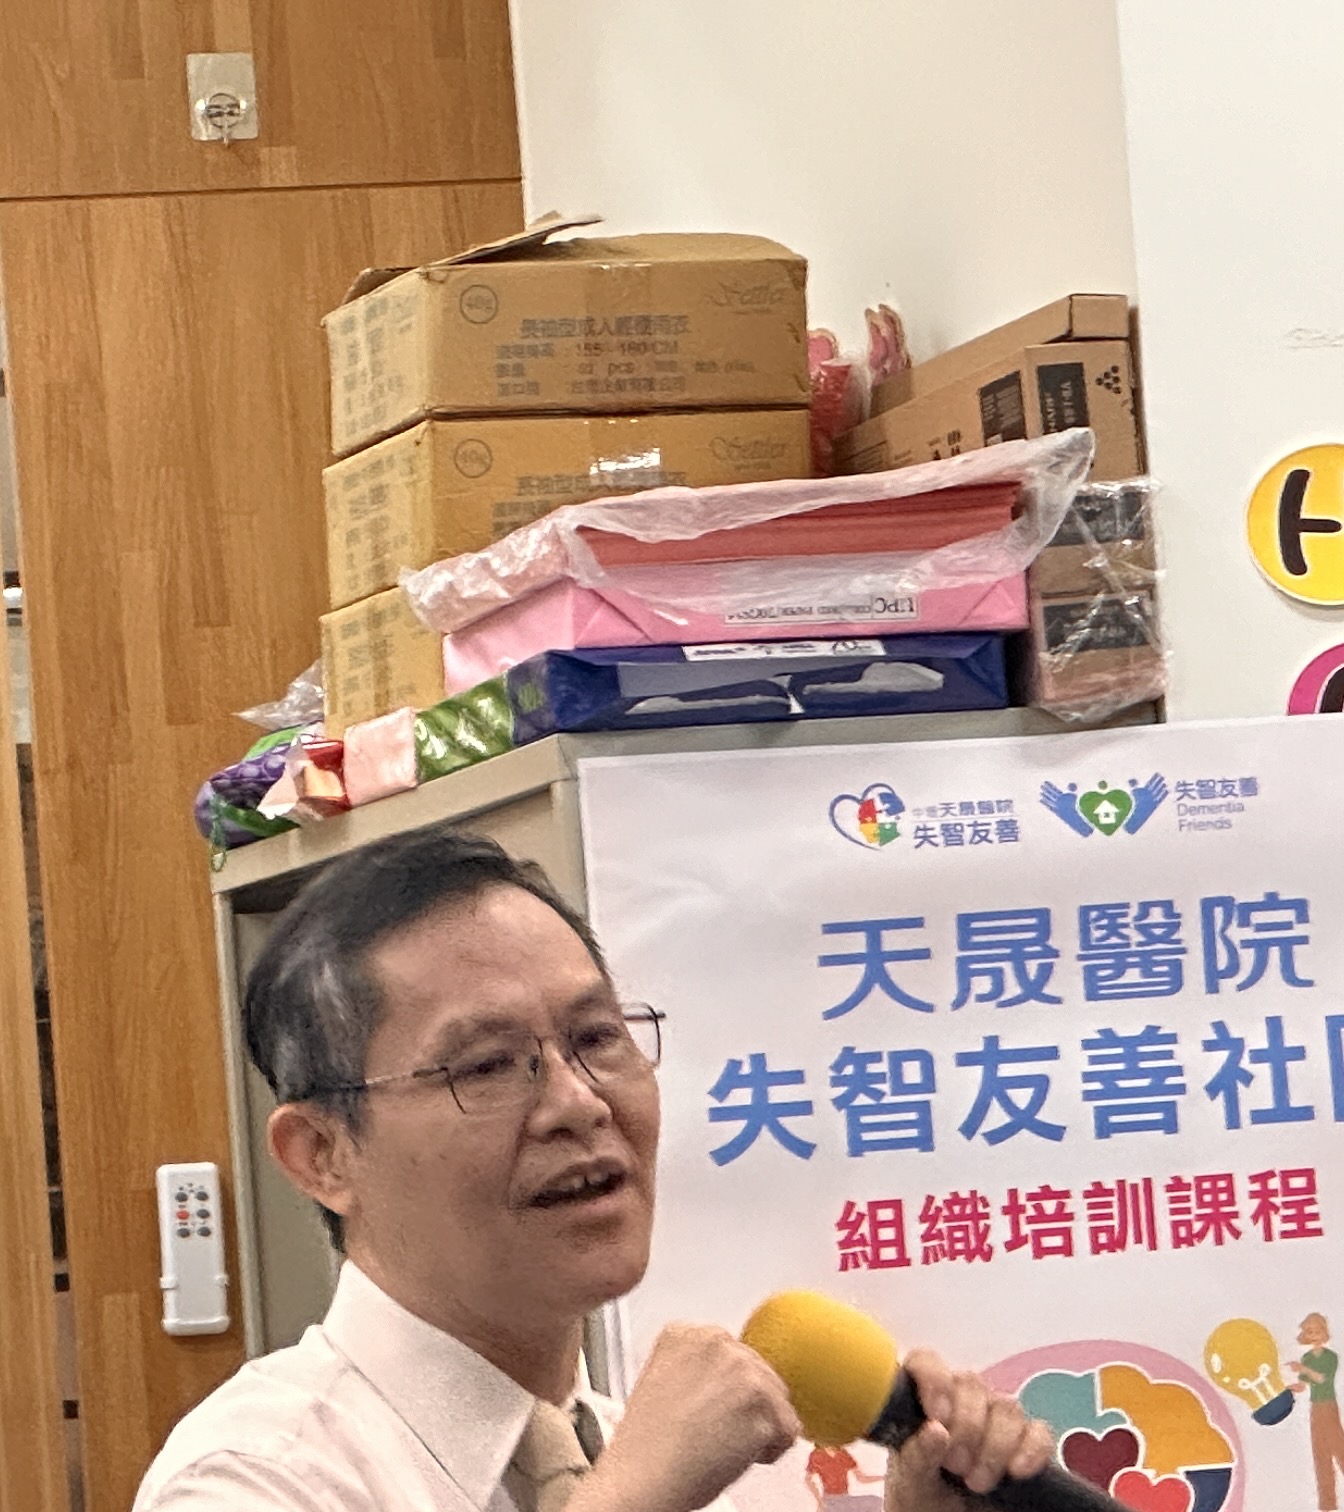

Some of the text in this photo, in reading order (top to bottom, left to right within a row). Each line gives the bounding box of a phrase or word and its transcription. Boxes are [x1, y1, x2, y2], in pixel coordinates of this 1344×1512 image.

[1173, 776, 1259, 801] 失智友善
[1176, 801, 1245, 817] Dementia
[913, 819, 1021, 849] 失智友善
[1177, 817, 1233, 832] Friends
[817, 891, 1317, 1022] 天晟醫院
[835, 1167, 1325, 1275] 組織培訓課程
